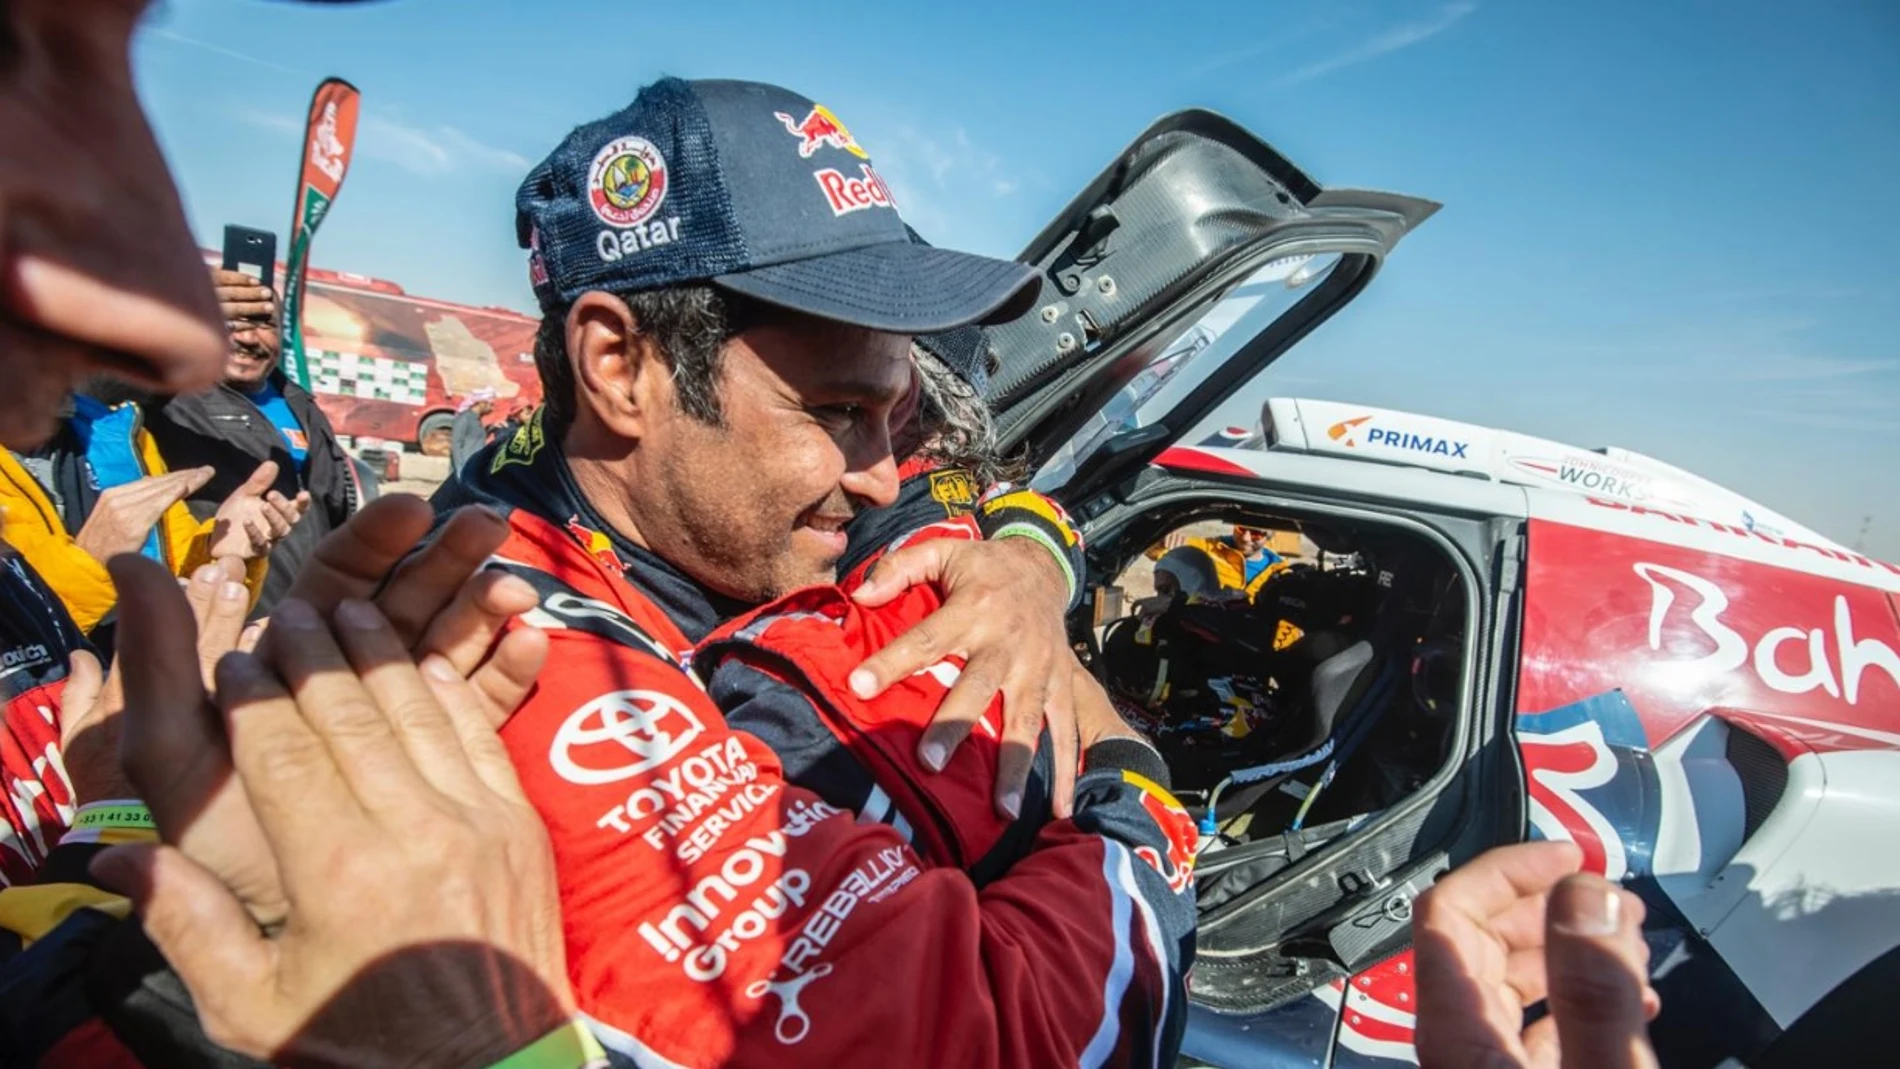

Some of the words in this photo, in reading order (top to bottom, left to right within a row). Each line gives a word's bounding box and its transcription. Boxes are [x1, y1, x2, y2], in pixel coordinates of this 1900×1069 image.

[596, 216, 681, 262] Qatar
[1367, 426, 1469, 459] PRIMAX
[596, 735, 749, 833] TOYOTA
[124, 812, 141, 822] 33
[683, 868, 811, 983] Group
